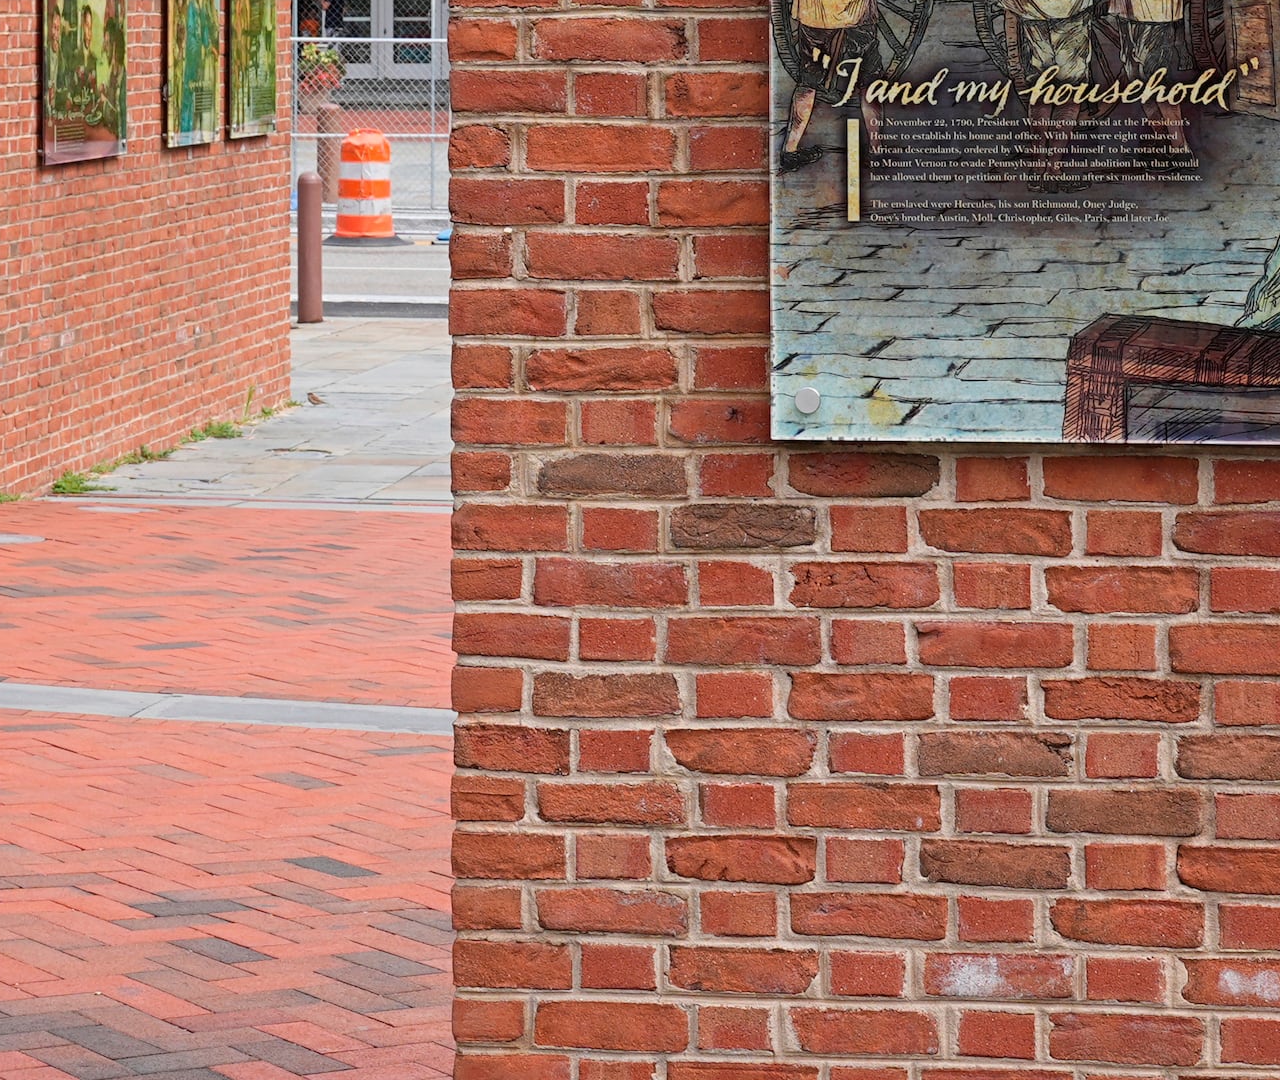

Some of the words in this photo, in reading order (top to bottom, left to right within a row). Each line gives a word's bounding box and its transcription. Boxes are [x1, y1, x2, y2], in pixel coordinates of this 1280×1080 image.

[865, 67, 950, 106] and
[948, 79, 1013, 119] my
[1017, 56, 1260, 112] household"
[869, 118, 884, 127] On
[885, 118, 933, 127] November
[933, 118, 949, 128] 22,
[950, 118, 975, 128] 1790,
[976, 118, 1020, 127] President
[1021, 118, 1078, 130] Washington
[1078, 118, 1111, 127] arrived
[1112, 118, 1122, 127] at
[1124, 118, 1140, 127] the
[1141, 118, 1191, 127] President's
[870, 131, 899, 141] House
[900, 131, 911, 141] to
[912, 131, 952, 141] establish
[953, 131, 967, 141] his
[968, 131, 994, 141] home
[995, 131, 1013, 141] and
[1014, 131, 1042, 141] office.
[1043, 131, 1068, 141] With
[1070, 131, 1088, 141] him
[1089, 133, 1112, 141] were
[1113, 131, 1138, 143] eight
[1139, 131, 1178, 141] enslaved
[869, 145, 903, 154] African
[904, 145, 962, 156] descendants,
[963, 145, 999, 154] ordered
[1000, 145, 1012, 157] by
[1013, 145, 1069, 157] Washington
[1070, 145, 1106, 154] himself
[1108, 145, 1119, 154] to
[1120, 145, 1132, 154] be
[1133, 145, 1167, 154] rotated
[1168, 145, 1190, 154] back
[870, 158, 881, 168] to
[882, 158, 912, 168] Mount
[914, 158, 947, 168] Vernon
[948, 158, 959, 168] to
[960, 158, 987, 168] evade
[988, 158, 1052, 170] Pennsylvania's
[1053, 158, 1089, 170] gradual
[1089, 158, 1131, 168] abolition
[1132, 158, 1149, 168] law
[1150, 158, 1169, 168] that
[1169, 158, 1199, 168] would
[870, 172, 891, 182] have
[892, 172, 927, 182] allowed
[928, 172, 952, 182] them
[954, 172, 964, 182] to
[965, 172, 1002, 184] petition
[1003, 172, 1018, 182] for
[1019, 172, 1042, 182] their
[1043, 172, 1081, 182] freedom
[1082, 172, 1105, 182] after
[1105, 172, 1120, 182] six
[1121, 172, 1157, 182] months
[1157, 172, 1203, 182] residence.
[871, 199, 889, 209] The
[890, 199, 929, 209] enslaved
[930, 201, 952, 209] were
[954, 199, 997, 210] Hercules,
[998, 199, 1012, 209] his
[1014, 201, 1030, 209] son
[1031, 199, 1081, 210] Richmond,
[1082, 199, 1107, 212] Oney
[1108, 199, 1139, 212] Judge,
[869, 213, 900, 225] Oney's
[901, 213, 936, 223] brother
[939, 213, 970, 224] Austin,
[971, 213, 996, 224] Moll,
[997, 213, 1054, 225] Christopher,
[1055, 213, 1082, 224] Giles,
[1084, 213, 1110, 224] Paris,
[1111, 213, 1129, 223] and
[1130, 213, 1151, 223] later
